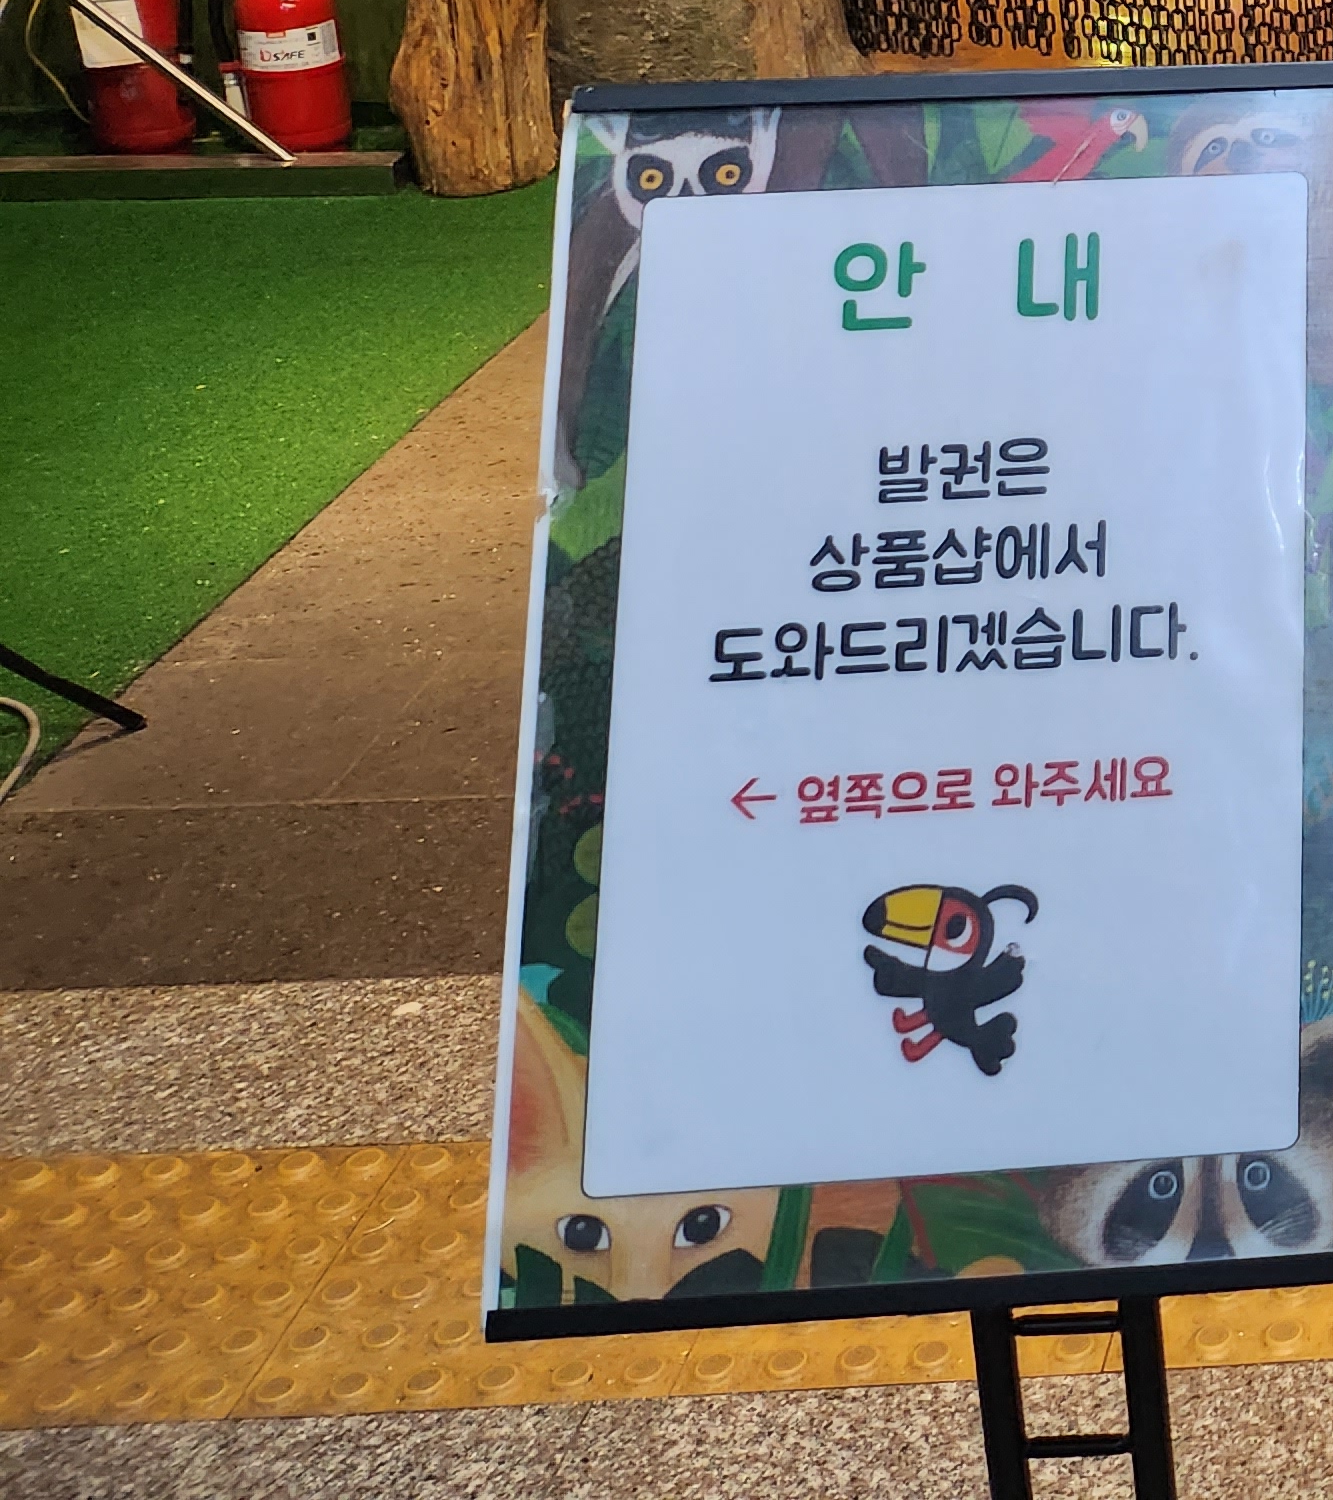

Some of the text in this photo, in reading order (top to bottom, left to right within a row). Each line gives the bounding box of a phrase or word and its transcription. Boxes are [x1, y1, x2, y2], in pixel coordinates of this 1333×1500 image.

[876, 435, 1050, 505] 발권은
[807, 519, 1109, 593] 상품샵에서
[708, 602, 1200, 685] 도와드리겠습니다.
[796, 756, 1174, 825] 옆쪽으로 와주세요
